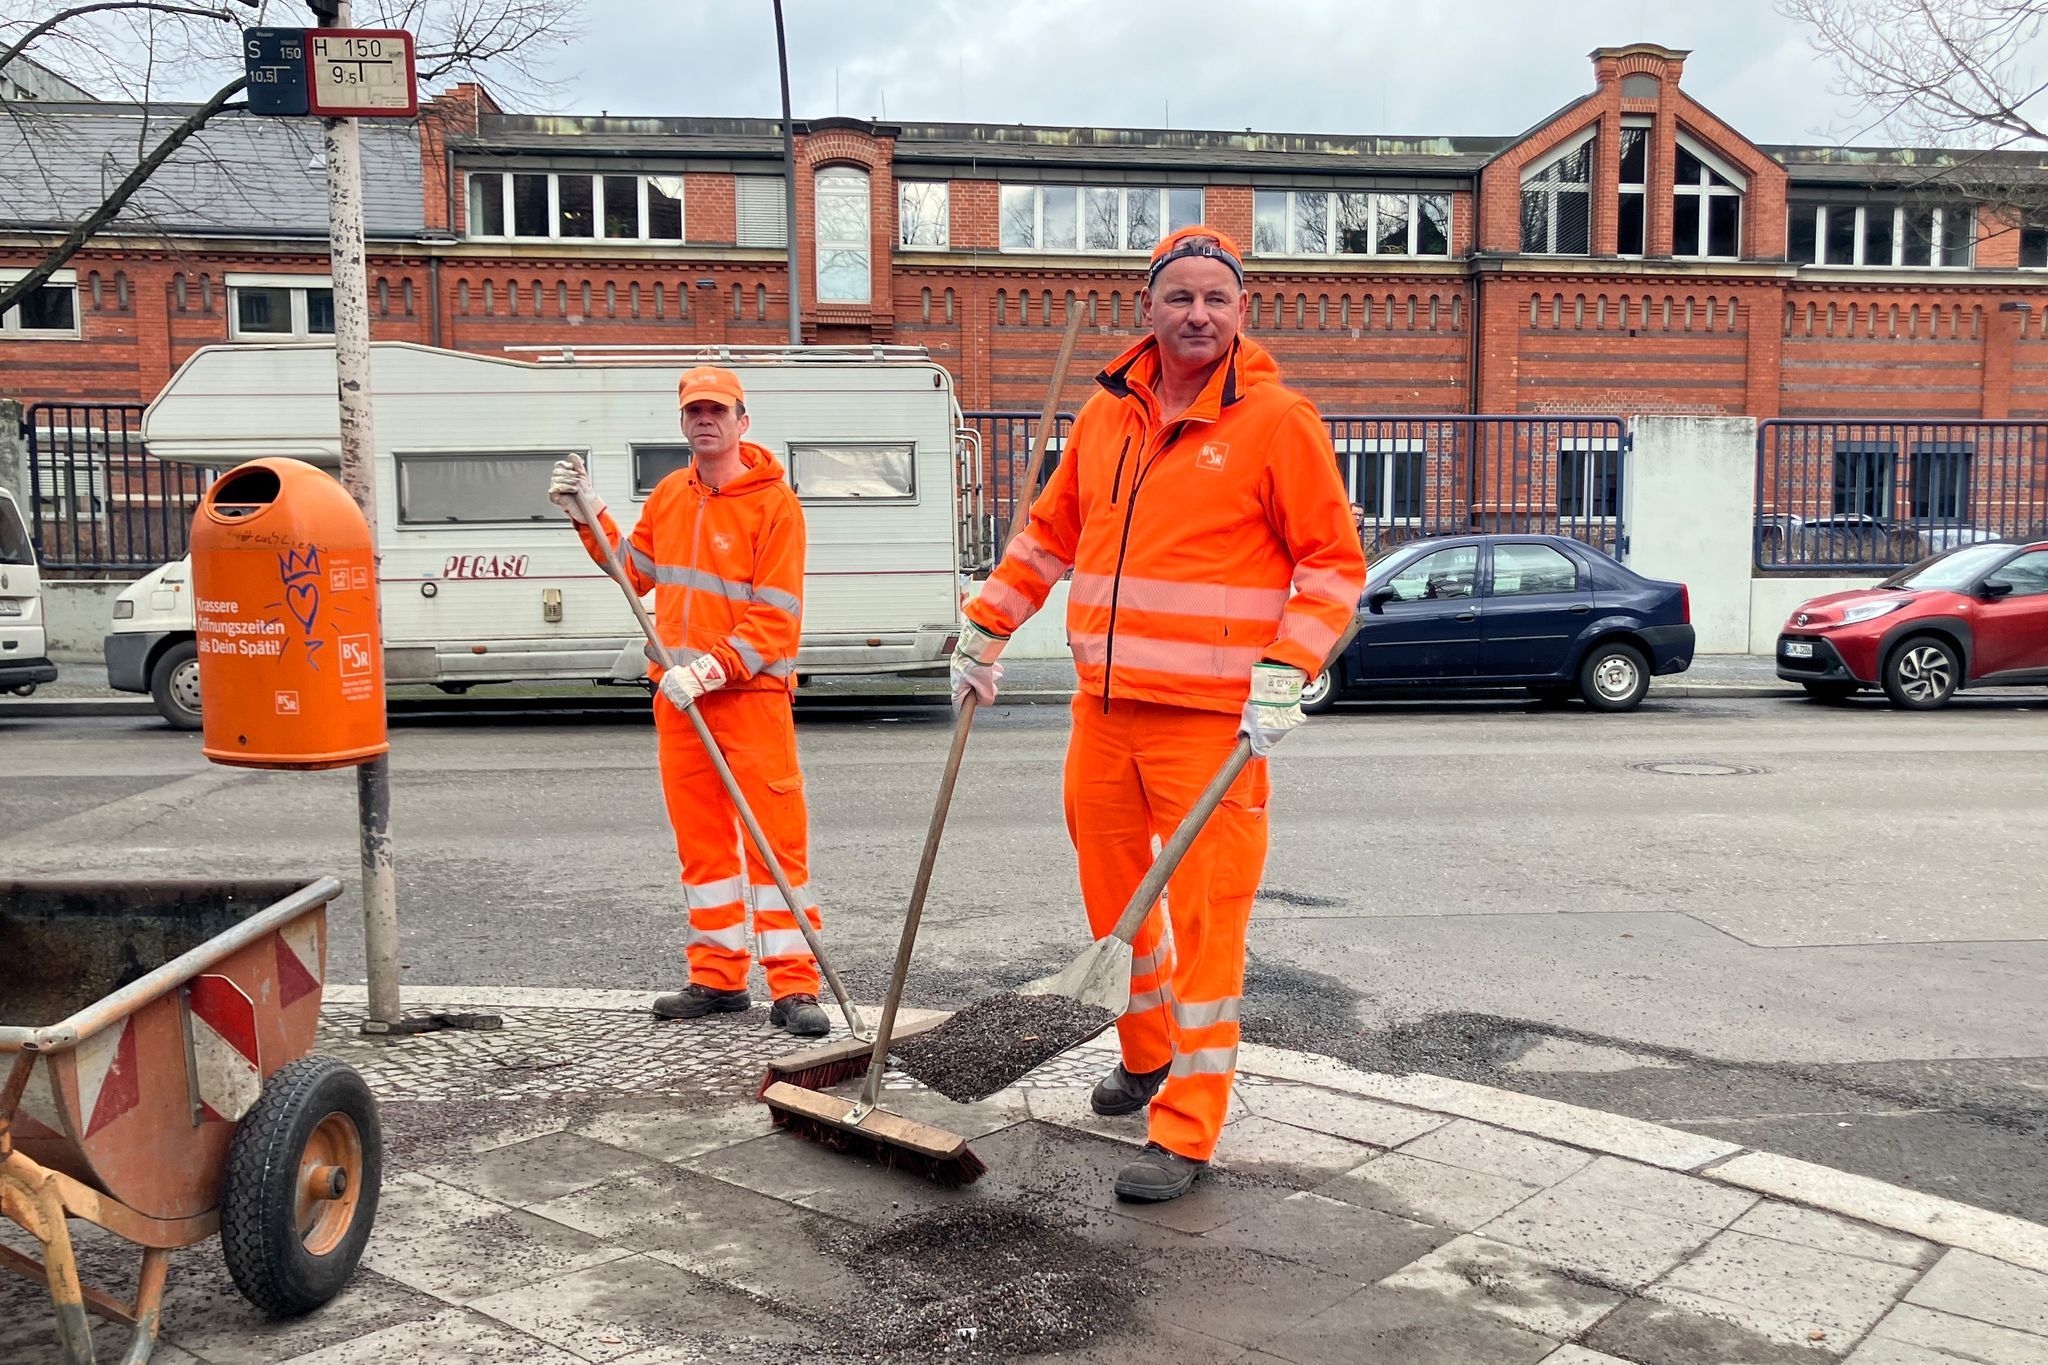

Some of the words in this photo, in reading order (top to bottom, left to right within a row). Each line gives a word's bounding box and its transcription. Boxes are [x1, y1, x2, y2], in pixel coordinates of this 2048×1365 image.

[247, 40, 261, 58] S
[280, 47, 301, 59] 150
[314, 39, 328, 57] H
[345, 39, 381, 58] 150
[250, 70, 274, 83] 10.5
[332, 66, 357, 85] 9.5
[443, 554, 530, 578] PEGASO
[196, 597, 239, 614] Krassere
[198, 615, 285, 637] Öffnungszeiten
[200, 638, 210, 653] als
[211, 638, 237, 655] Dein
[239, 639, 281, 658] Späti!
[342, 642, 369, 669] BSR
[277, 695, 297, 710] BSR
